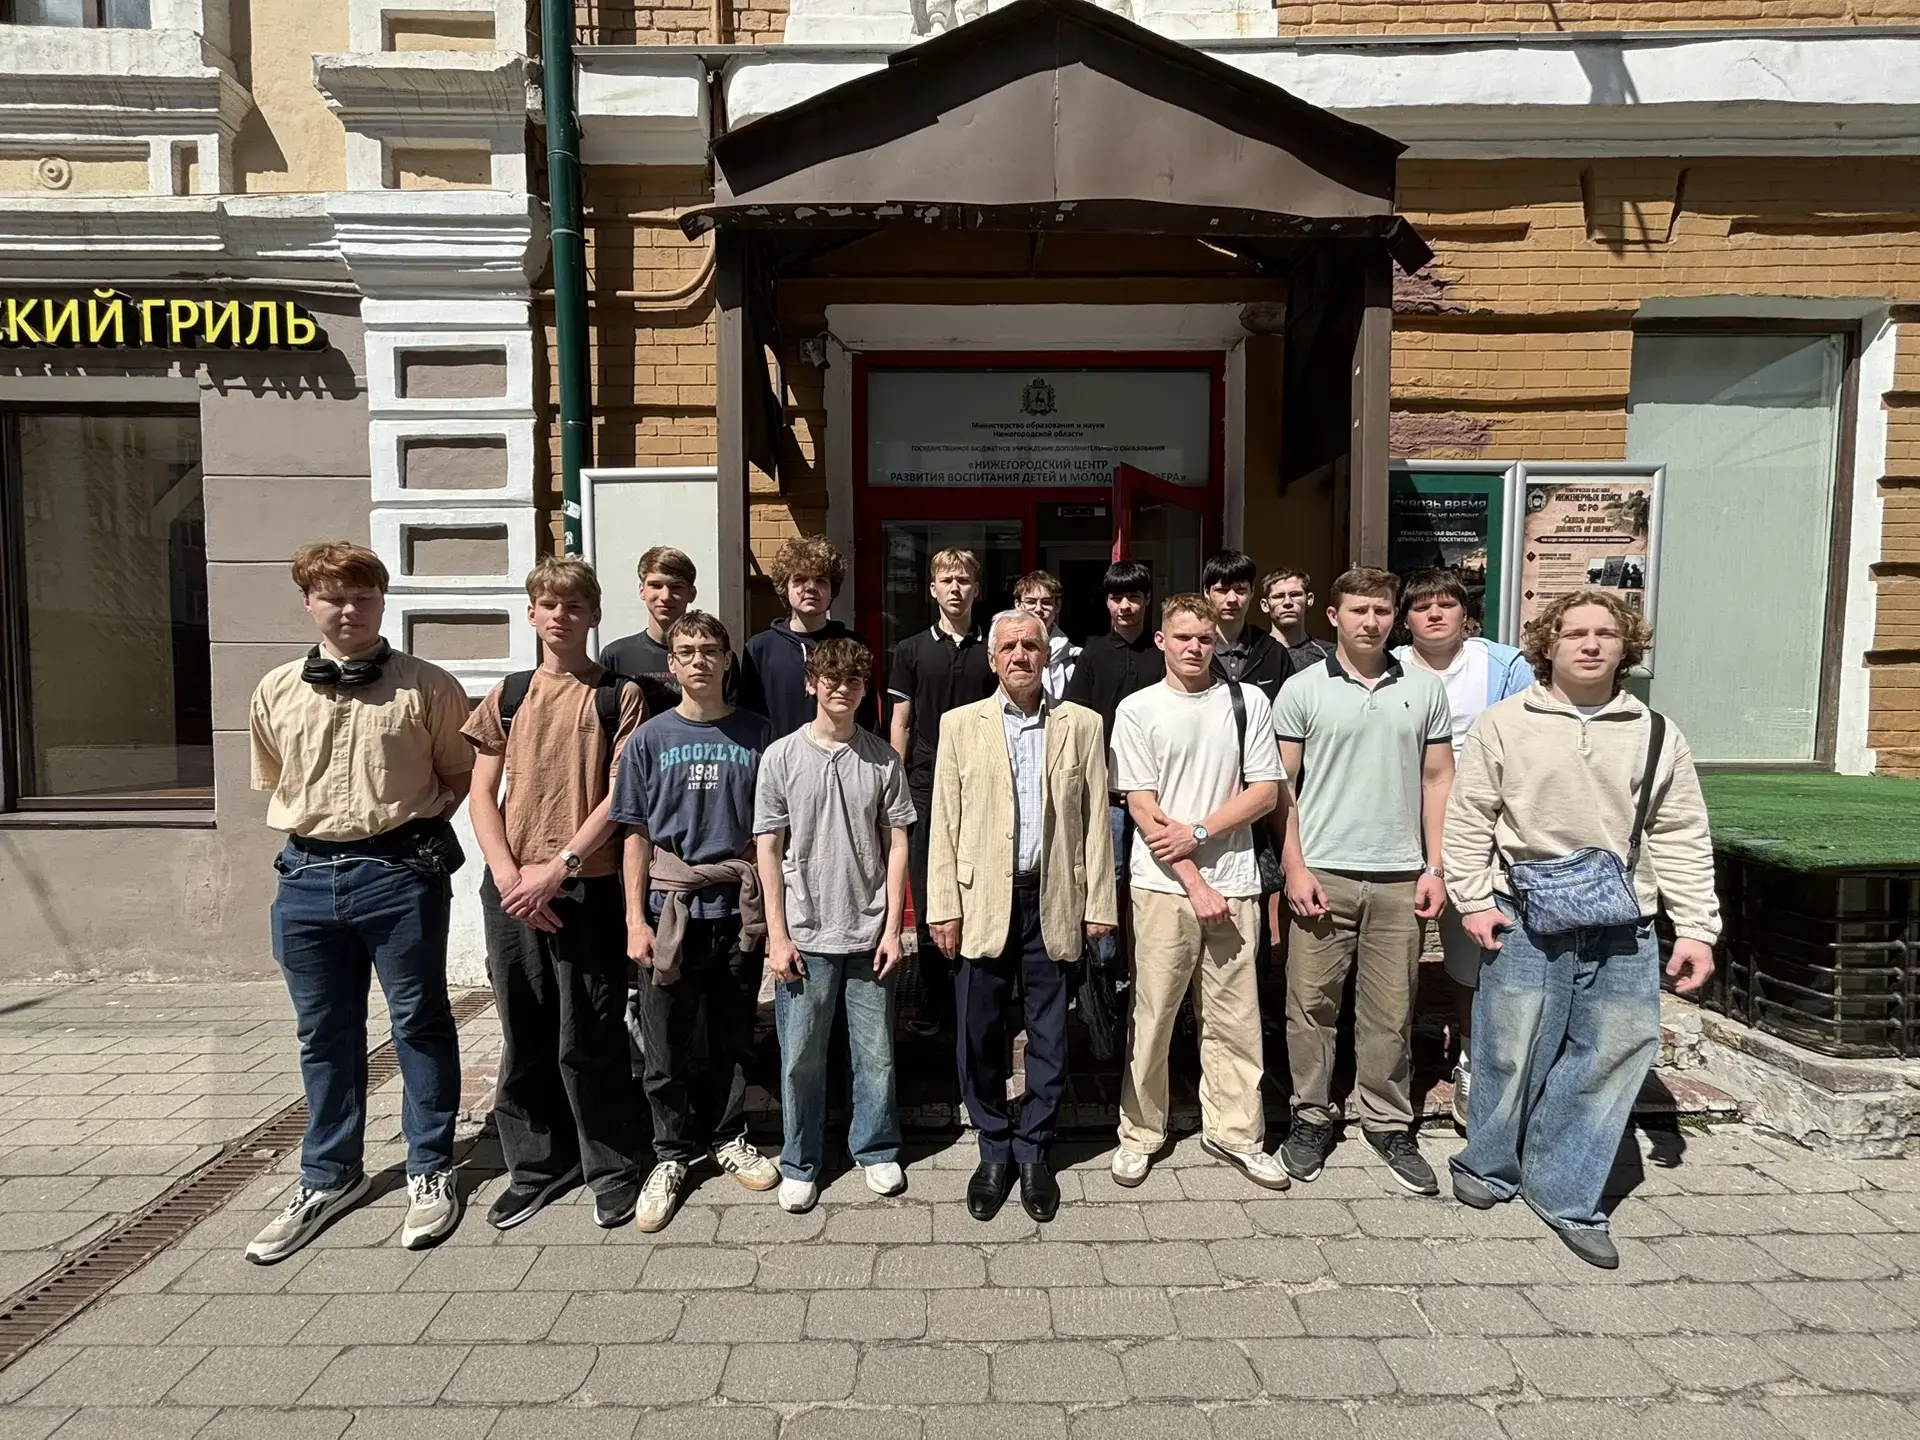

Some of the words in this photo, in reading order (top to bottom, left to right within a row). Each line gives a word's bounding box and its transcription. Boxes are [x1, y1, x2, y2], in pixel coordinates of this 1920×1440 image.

[0, 288, 125, 344] КИЙ
[142, 299, 317, 345] ГРИЛЬ
[971, 422, 1024, 430] Министерство
[1026, 421, 1075, 430] образования
[968, 459, 1071, 470] «НИЖЕГОРОДСКИЙ
[1074, 460, 1109, 470] ЦЕНТР
[890, 472, 945, 482] РАЗВИТИЯ
[948, 472, 1020, 482] ВОСПИТАНИЯ
[1022, 471, 1056, 483] ДЕТЕЙ
[1059, 473, 1067, 482] И
[1070, 472, 1112, 483] МОЛОД
[1555, 493, 1599, 502] ИНЖЕНЕРНЫХ
[1601, 491, 1622, 502] ВОЙСК
[1444, 500, 1487, 510] ВРЕМЯ
[1577, 504, 1587, 512] ВС
[1588, 503, 1599, 512] РФ
[659, 742, 751, 772] BROOKLYN
[688, 763, 719, 781] 1981
